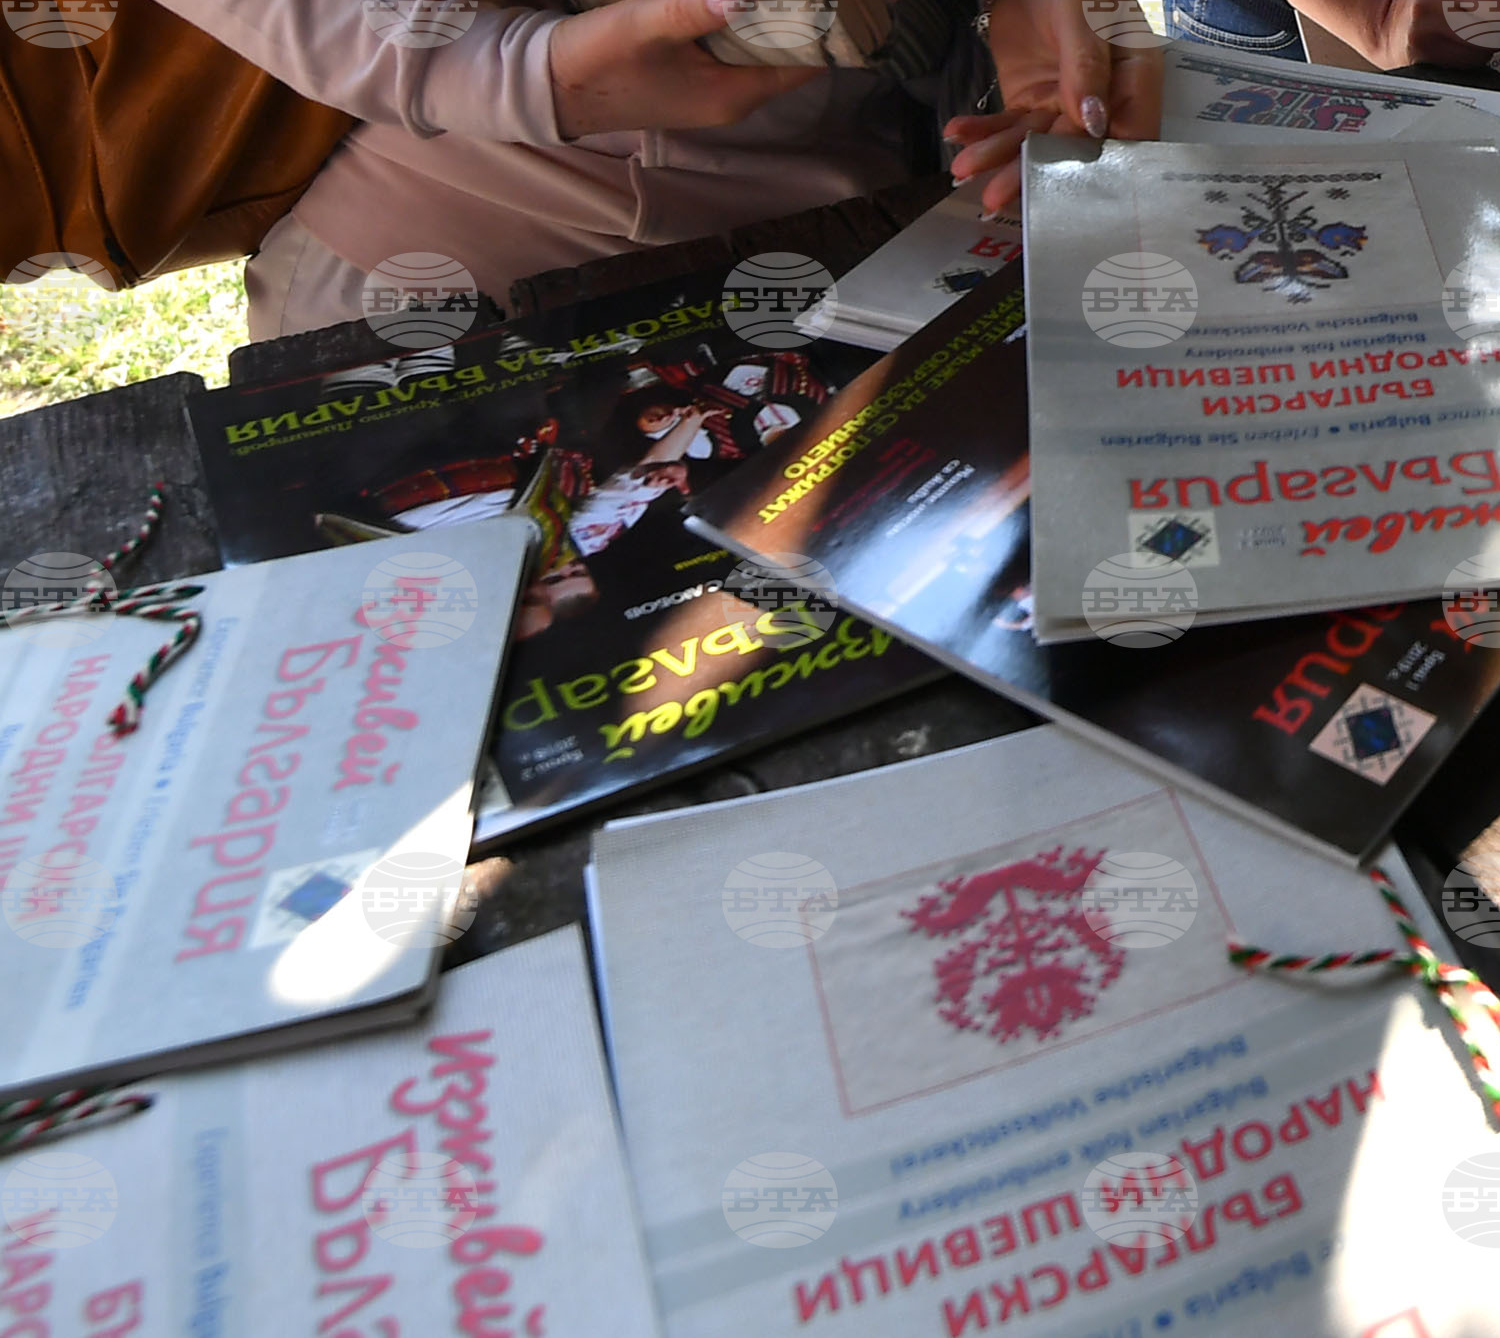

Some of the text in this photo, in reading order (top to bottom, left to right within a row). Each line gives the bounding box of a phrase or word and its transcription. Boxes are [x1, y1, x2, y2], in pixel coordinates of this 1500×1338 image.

[495, 346, 552, 371] ЗА
[570, 292, 743, 353] РАБОТЯ
[224, 366, 485, 443] БЪЛГАРИЯ
[1115, 362, 1296, 389] ШЕВИЦИ
[1201, 378, 1435, 417] БЪЛГАРСКИ
[783, 350, 950, 479] ОБРАЗОВАНИЕТО
[865, 412, 898, 439] СЕ
[1348, 410, 1432, 434] Bulgaria
[757, 434, 872, 525] ПОГРИЖАТ
[1127, 449, 1500, 509] България
[707, 579, 723, 593] С
[503, 600, 817, 732] Българ
[0, 652, 113, 830] НАРОДНИ
[14, 732, 127, 922] ЪЛГАРСКИ
[173, 633, 363, 965] България
[793, 1068, 1387, 1326] НАРОДНИ ШЕВИЦИ
[940, 1172, 1303, 1338] БЪЛГАРСКИ
